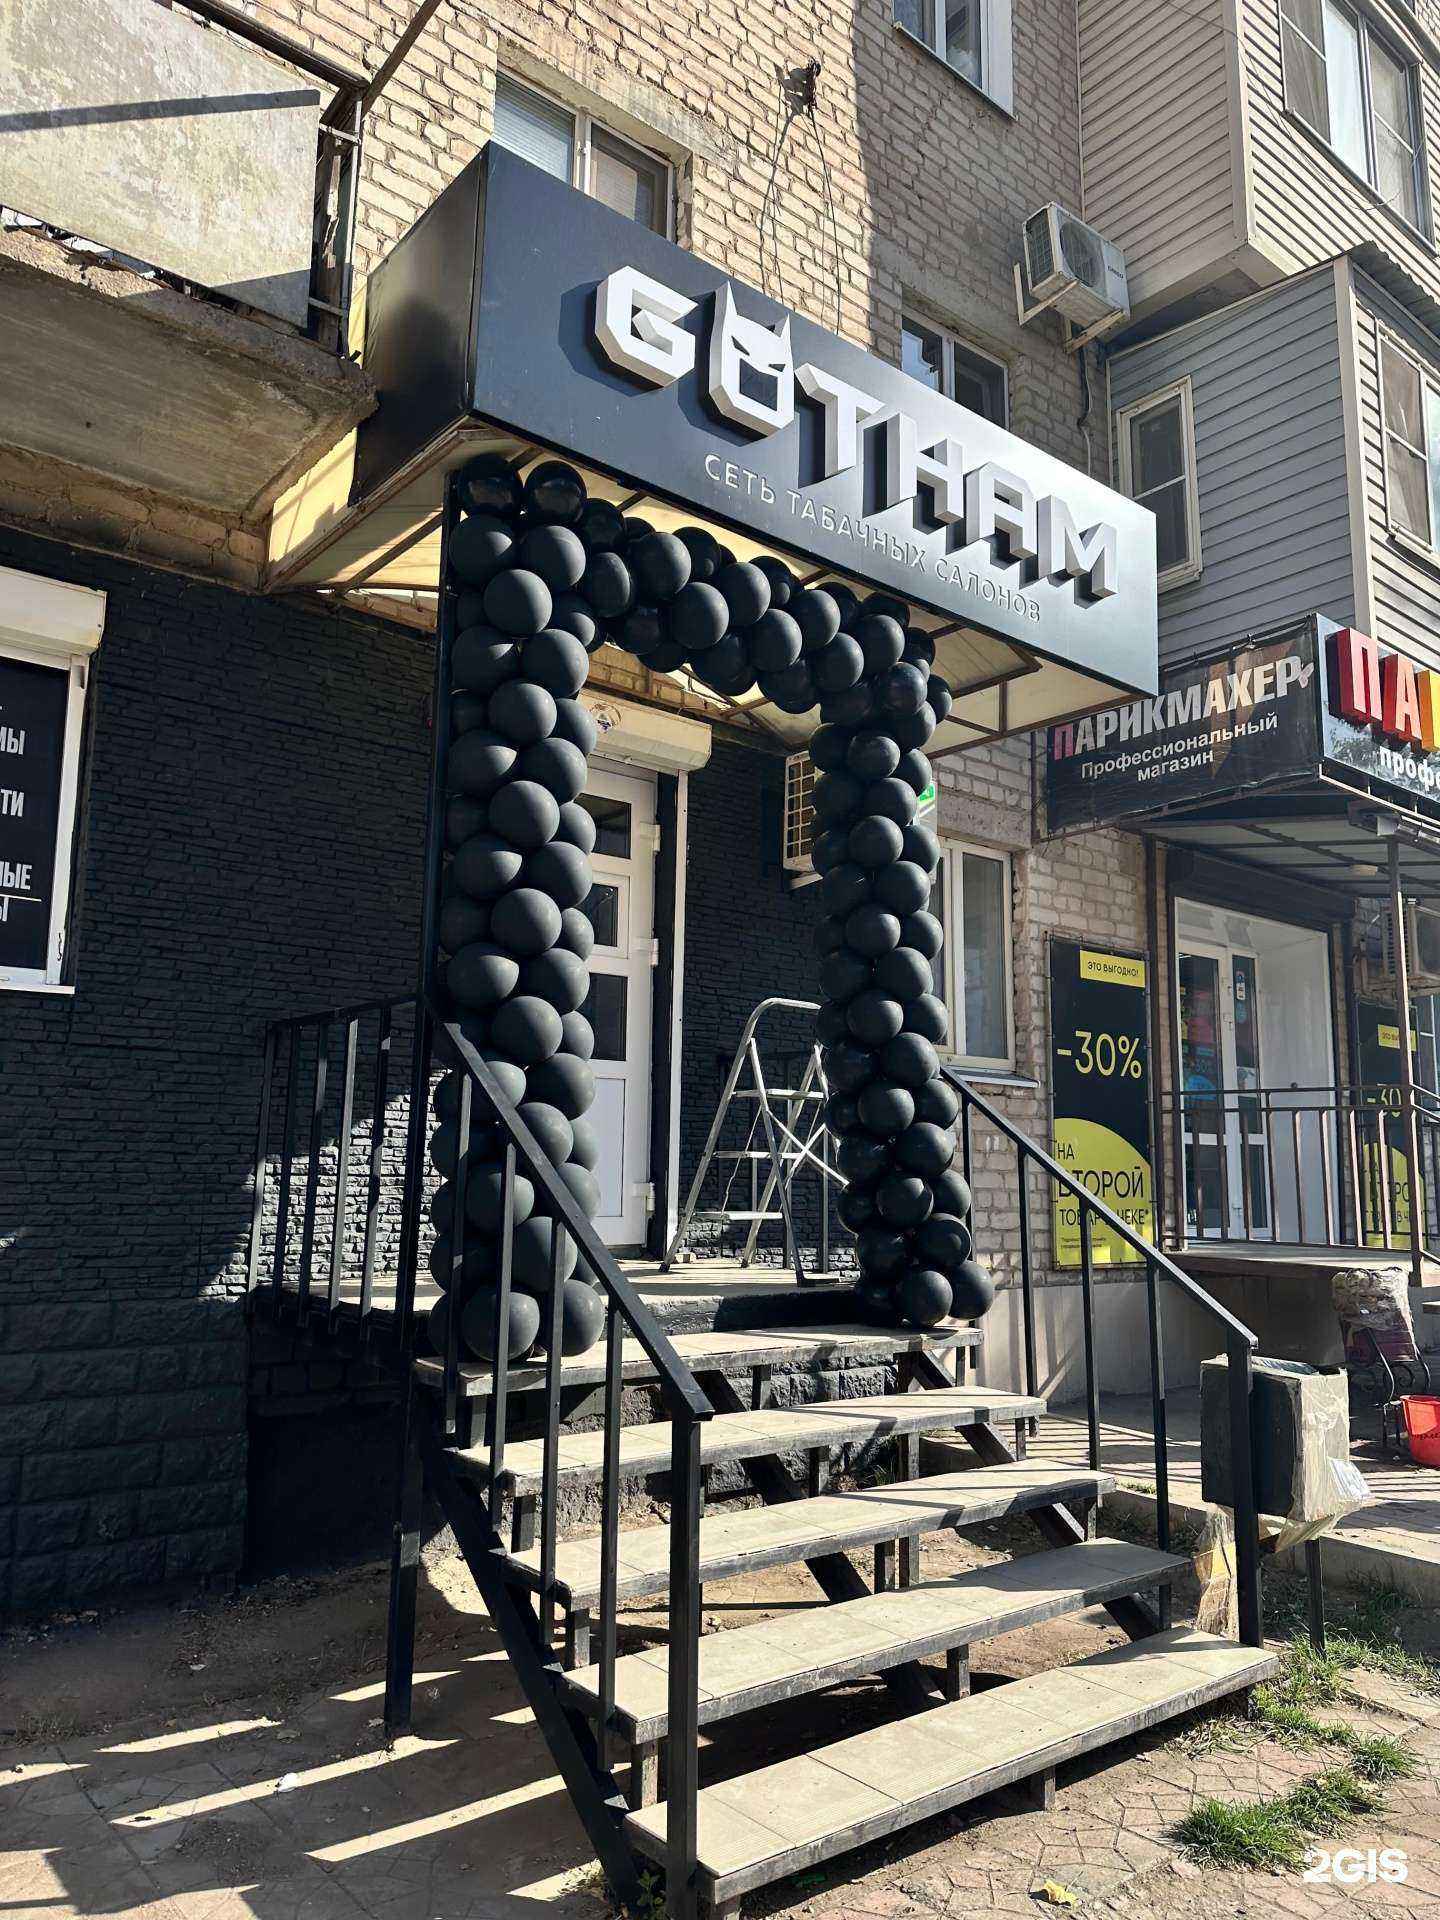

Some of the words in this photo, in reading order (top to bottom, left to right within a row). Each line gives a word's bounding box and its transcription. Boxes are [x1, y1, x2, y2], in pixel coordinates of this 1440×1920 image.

[595, 265, 1118, 602] GOTHAM
[704, 453, 777, 504] СЕТЬ
[787, 488, 927, 575] ТАБАЧНЫХ
[934, 558, 1041, 623] САЛОНОВ
[1054, 655, 1302, 761] ПАРИКМАХЕР
[1081, 711, 1279, 779] Профессиональный
[1137, 750, 1214, 782] магазин
[1087, 961, 1102, 972] ЭТО
[1103, 964, 1139, 977] ВЫГОДНО!
[1057, 1030, 1142, 1079] -30%
[1057, 1143, 1075, 1160] НА
